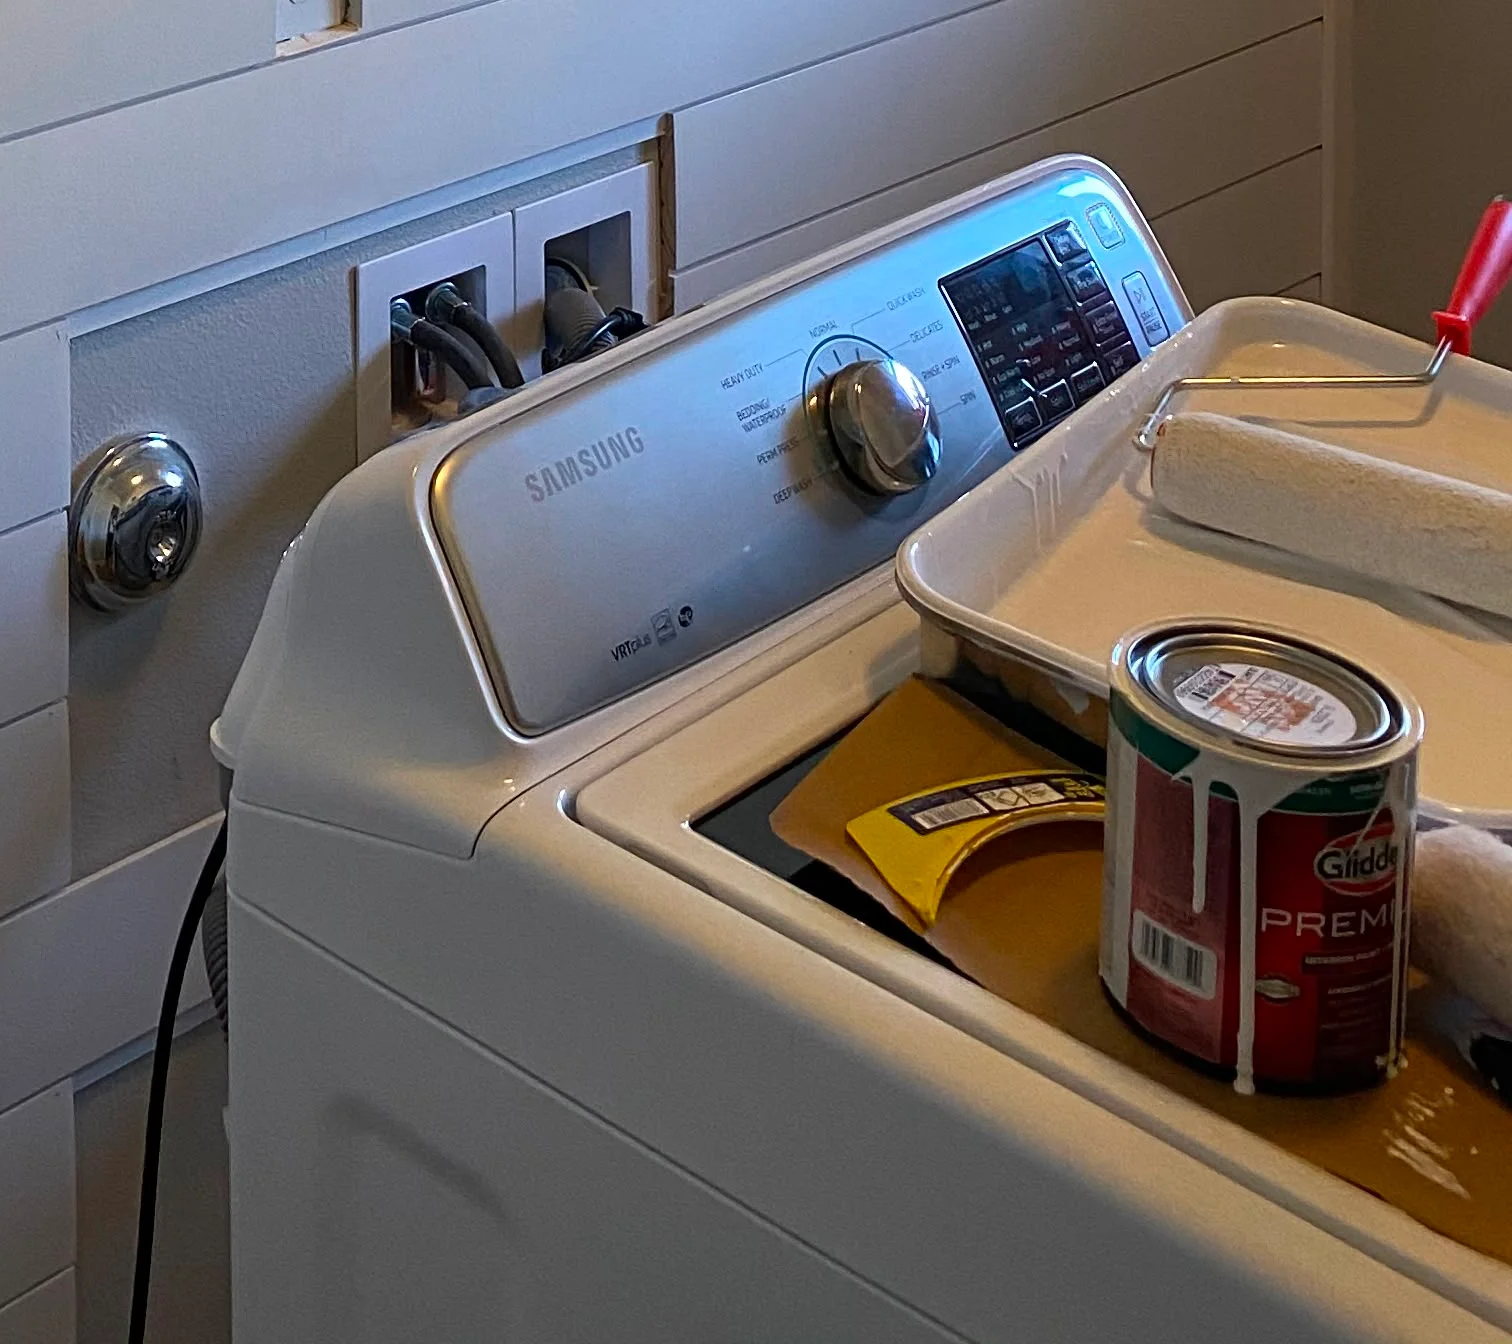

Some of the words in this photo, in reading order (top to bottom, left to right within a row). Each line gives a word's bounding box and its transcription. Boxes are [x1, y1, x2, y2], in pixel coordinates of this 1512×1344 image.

[808, 319, 839, 338] NORMAL
[909, 320, 944, 344] DELICATES
[720, 372, 745, 390] HEAVY
[743, 362, 764, 380] DUTY
[741, 404, 787, 433] WATERPROOF
[524, 425, 645, 503] SAMSUNG
[756, 448, 779, 464] PERM
[772, 486, 792, 505] DEEP
[1316, 841, 1399, 880] Glidde
[1260, 898, 1396, 938] PREMI
